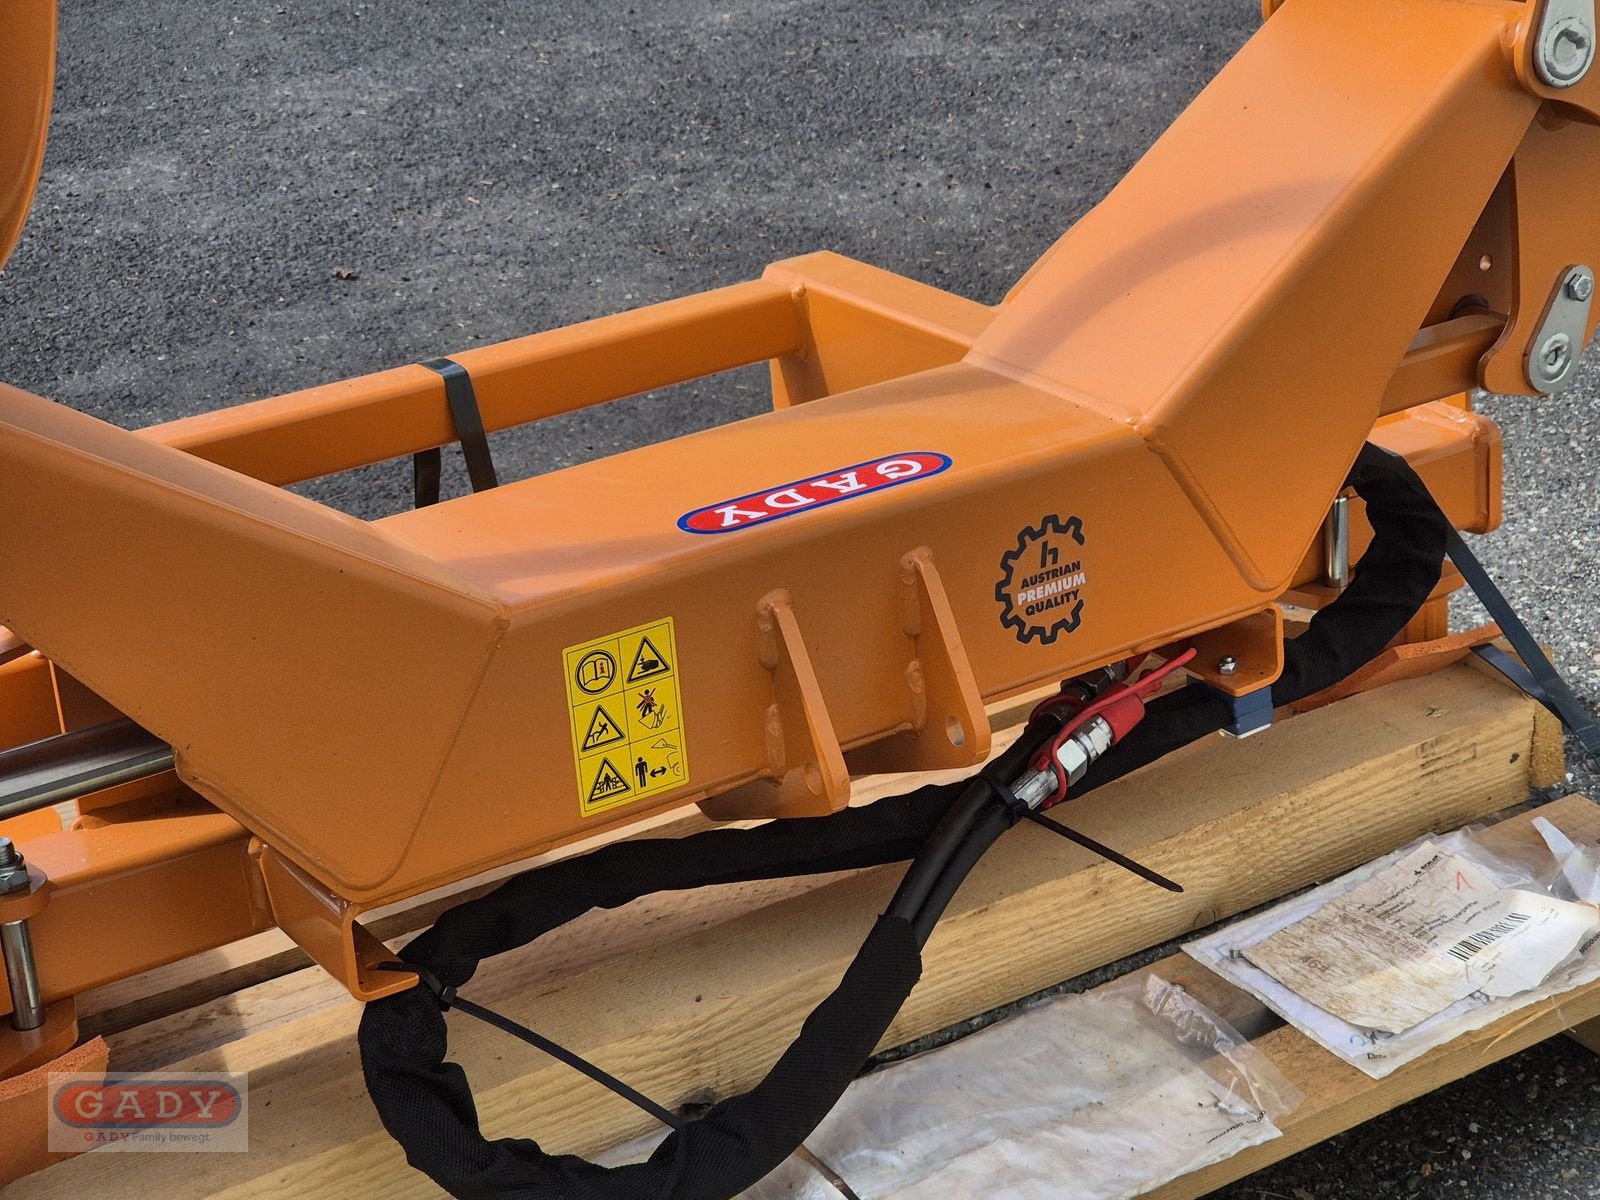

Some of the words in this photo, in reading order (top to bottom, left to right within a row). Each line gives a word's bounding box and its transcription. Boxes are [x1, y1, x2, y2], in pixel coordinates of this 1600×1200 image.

[714, 458, 923, 528] GADY
[1017, 572, 1087, 606] PREMIUM
[1021, 560, 1081, 590] AUSTRIAN
[1025, 589, 1080, 617] QUALITY
